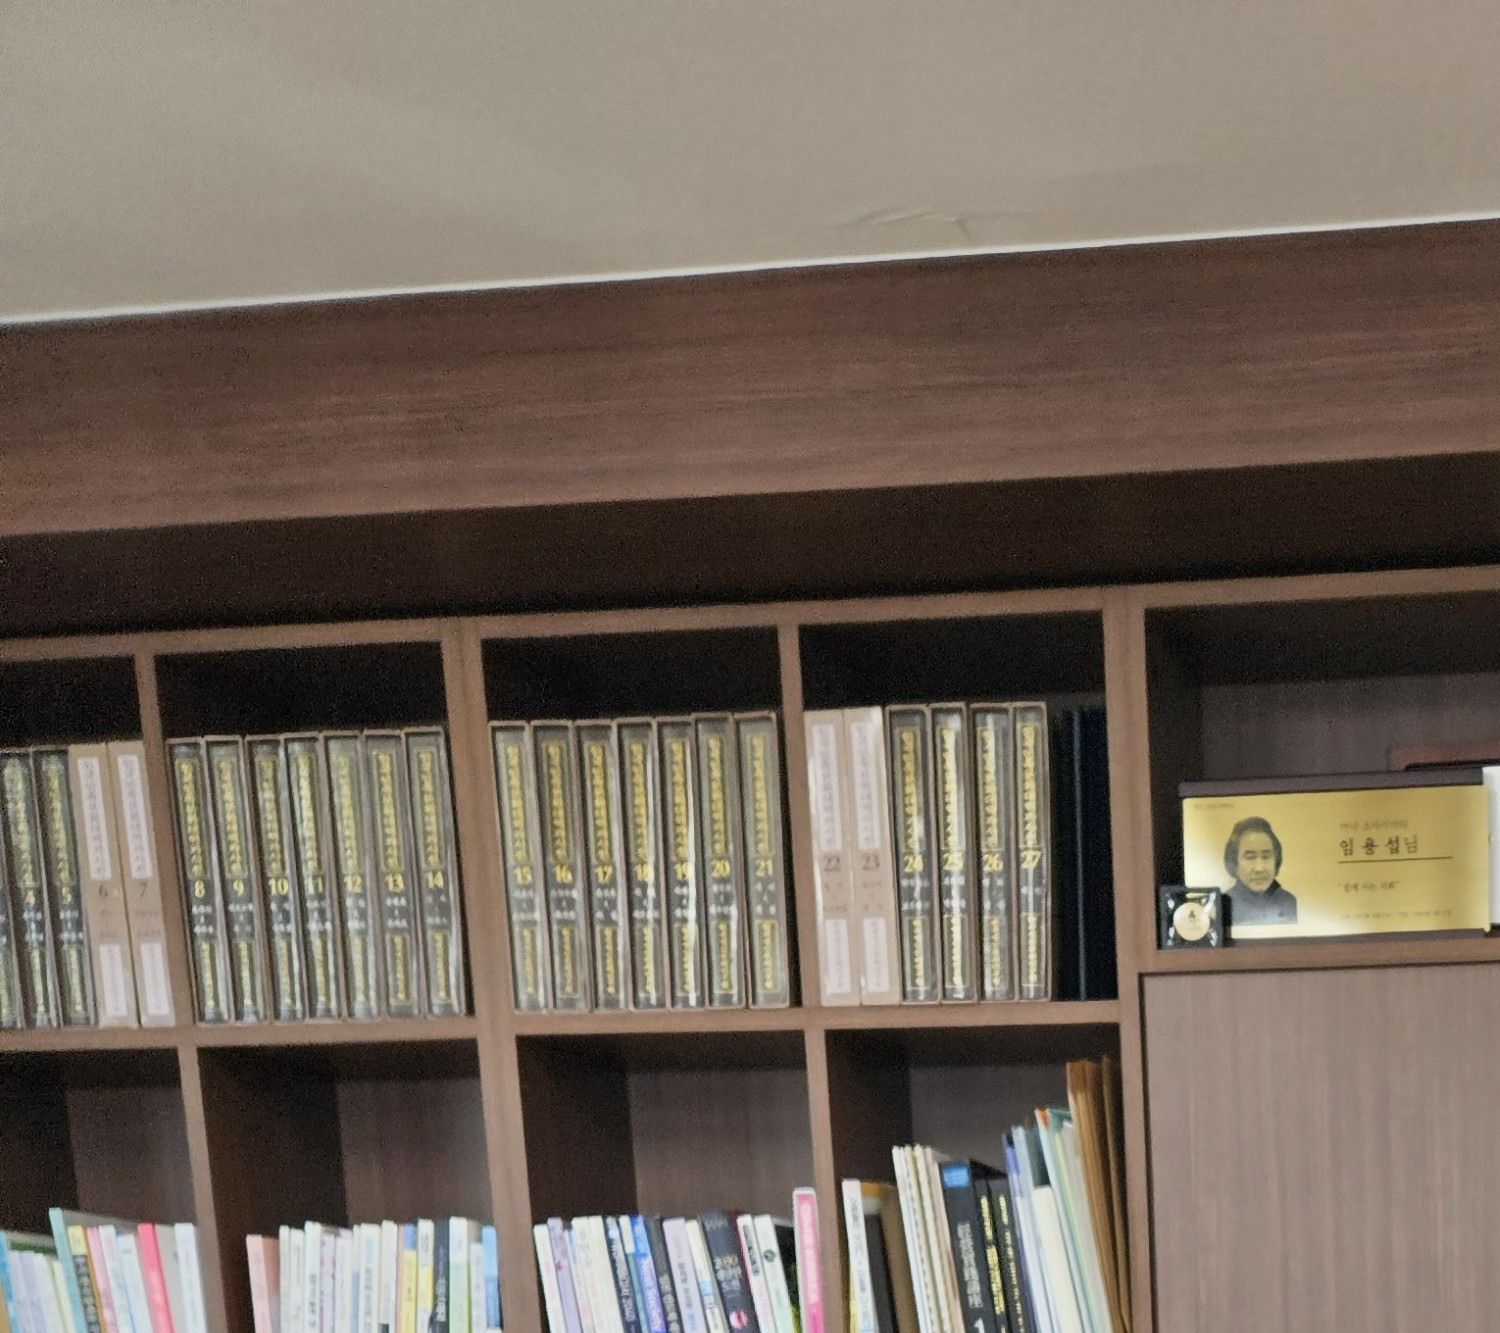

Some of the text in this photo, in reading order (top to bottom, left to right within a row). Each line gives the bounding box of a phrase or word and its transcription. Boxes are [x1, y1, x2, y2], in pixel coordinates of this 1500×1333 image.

[755, 859, 773, 877] 21
[823, 854, 841, 871] 22
[862, 853, 880, 870] 23
[903, 852, 923, 873] 24
[942, 852, 964, 871] 25
[981, 853, 1004, 872] 26
[1020, 850, 1041, 869] 27
[514, 867, 532, 885] 15
[554, 865, 573, 884] 16
[595, 865, 613, 884] 17
[711, 860, 730, 878] 20
[233, 879, 244, 896] 9
[268, 878, 289, 895] 10
[344, 874, 362, 893] 12
[384, 873, 404, 892] 13
[424, 871, 444, 888] 14
[194, 880, 205, 898] 8
